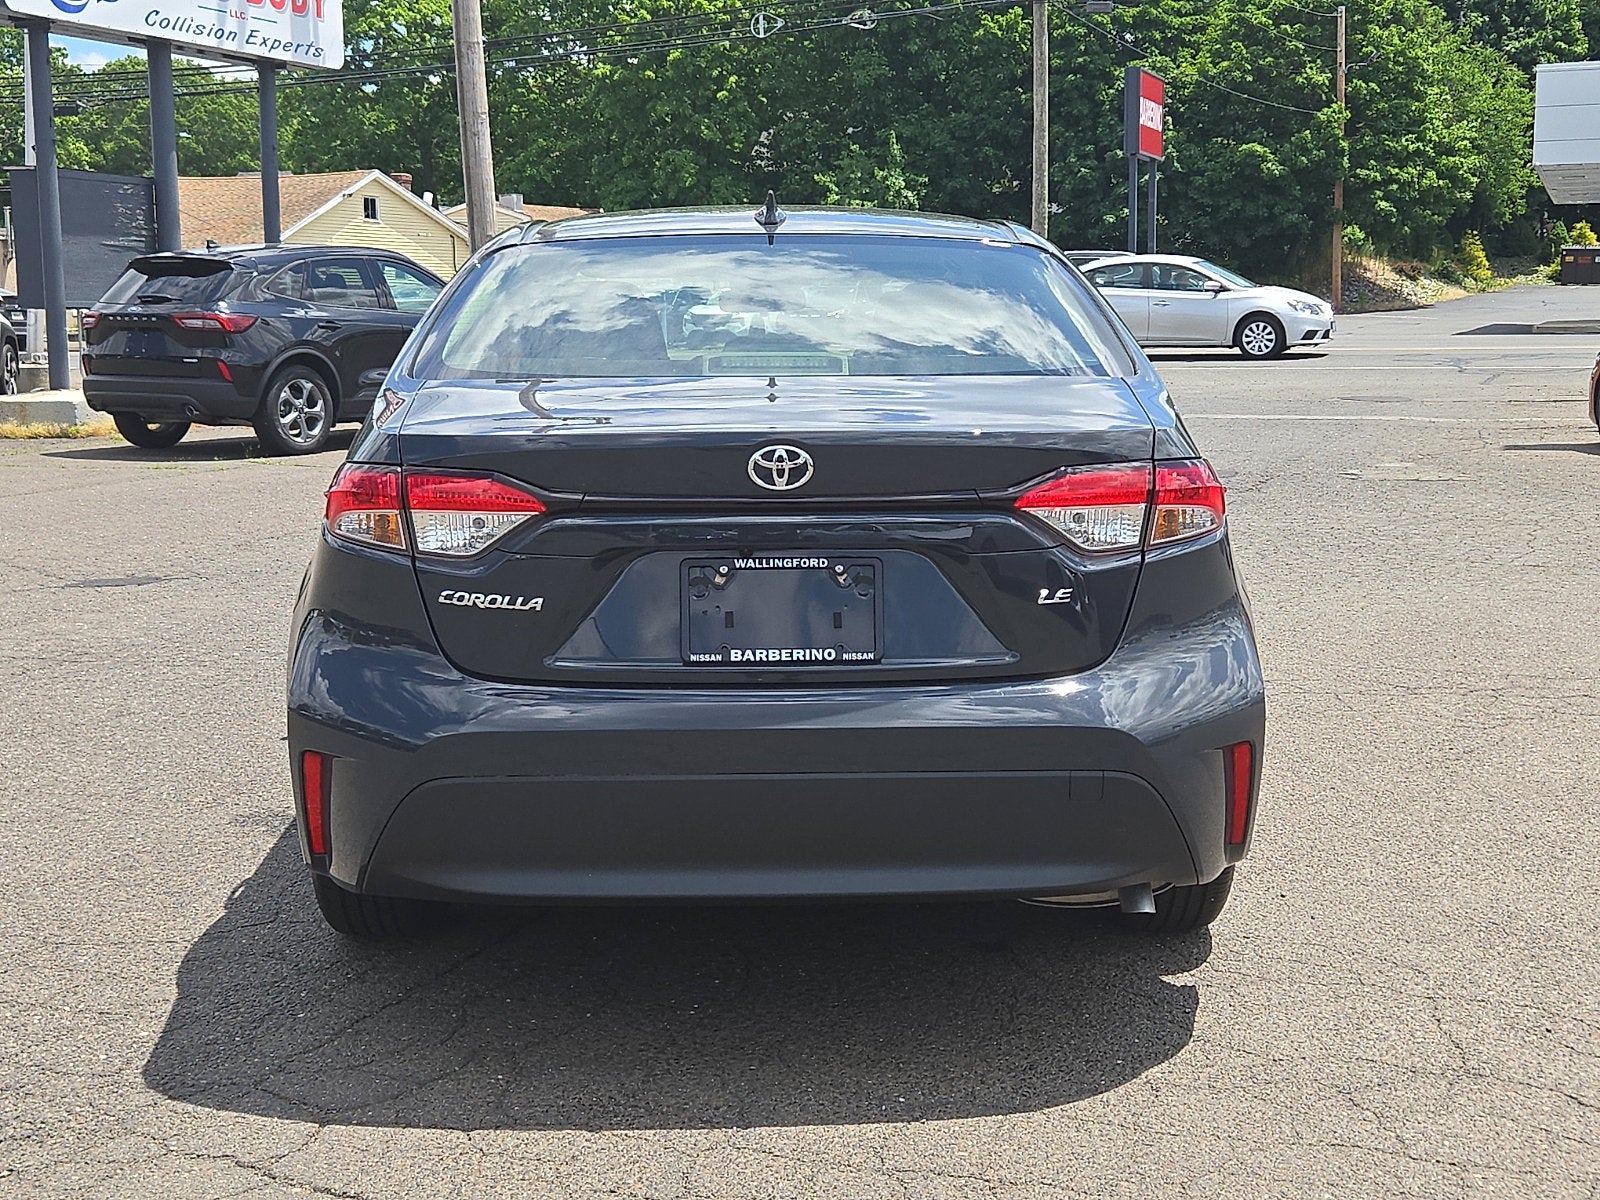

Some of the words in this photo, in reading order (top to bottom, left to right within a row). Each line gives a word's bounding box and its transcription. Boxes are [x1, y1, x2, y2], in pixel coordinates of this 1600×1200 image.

[144, 9, 238, 42] Collision
[246, 29, 325, 58] Experts
[734, 558, 829, 569] WALLINGFORD
[438, 590, 544, 611] COROLLA
[1037, 588, 1073, 605] LE
[690, 654, 723, 662] NISSAN
[730, 648, 836, 662] BARBERINO
[842, 652, 875, 661] NISSAN
